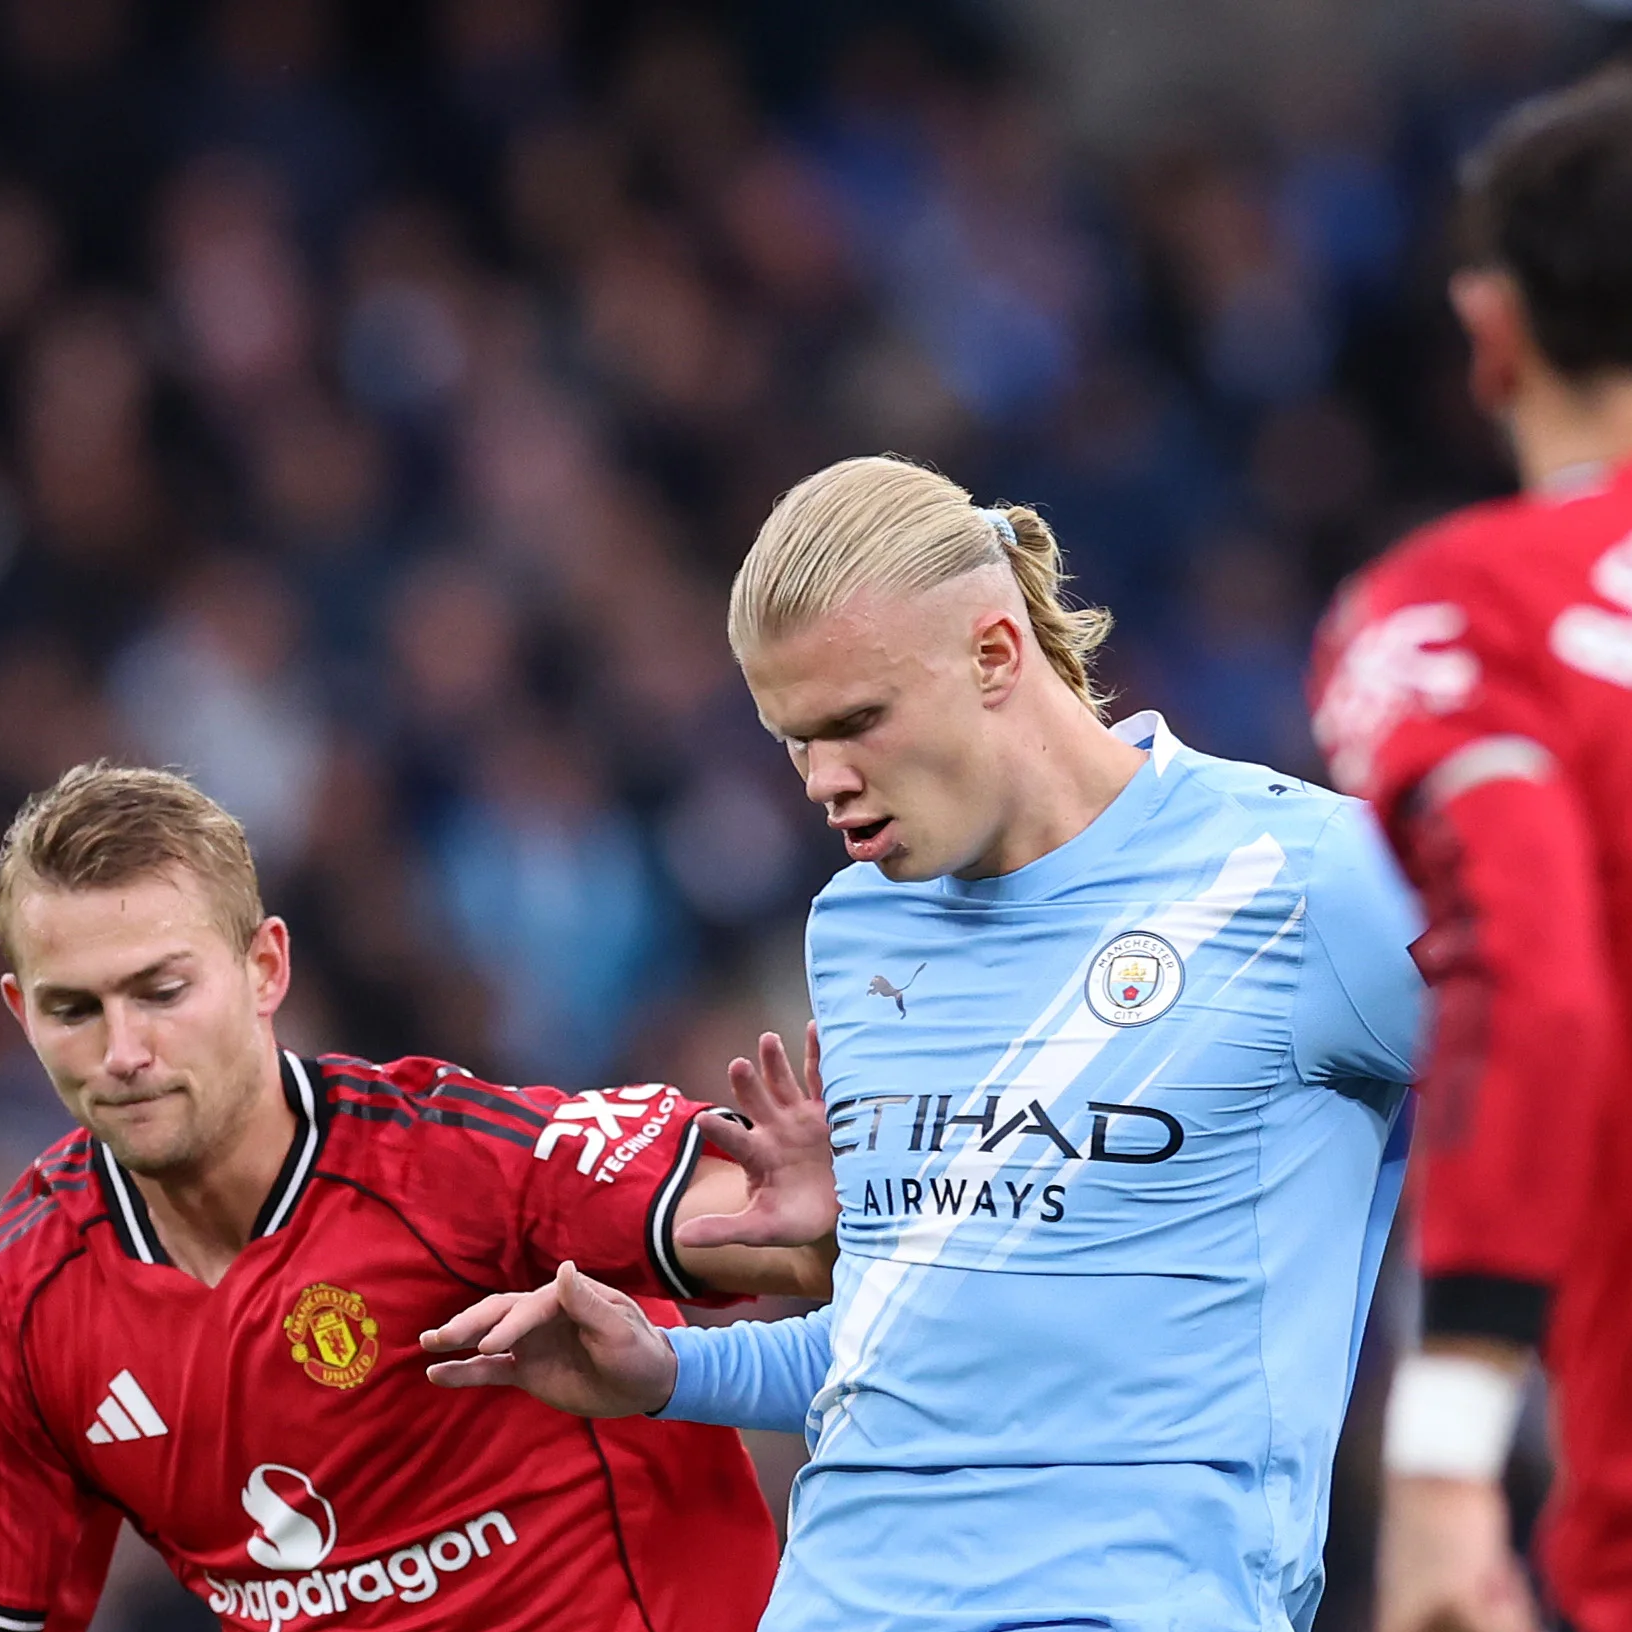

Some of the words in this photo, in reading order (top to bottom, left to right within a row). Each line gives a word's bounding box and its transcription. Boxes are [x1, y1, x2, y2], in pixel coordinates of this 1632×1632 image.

[1098, 939, 1175, 969] MANCHESTER
[1113, 1010, 1142, 1020] CITY
[827, 1094, 1185, 1165] ETIHAD
[863, 1177, 1067, 1223] AIRWAYS
[322, 1355, 372, 1379] UNITED
